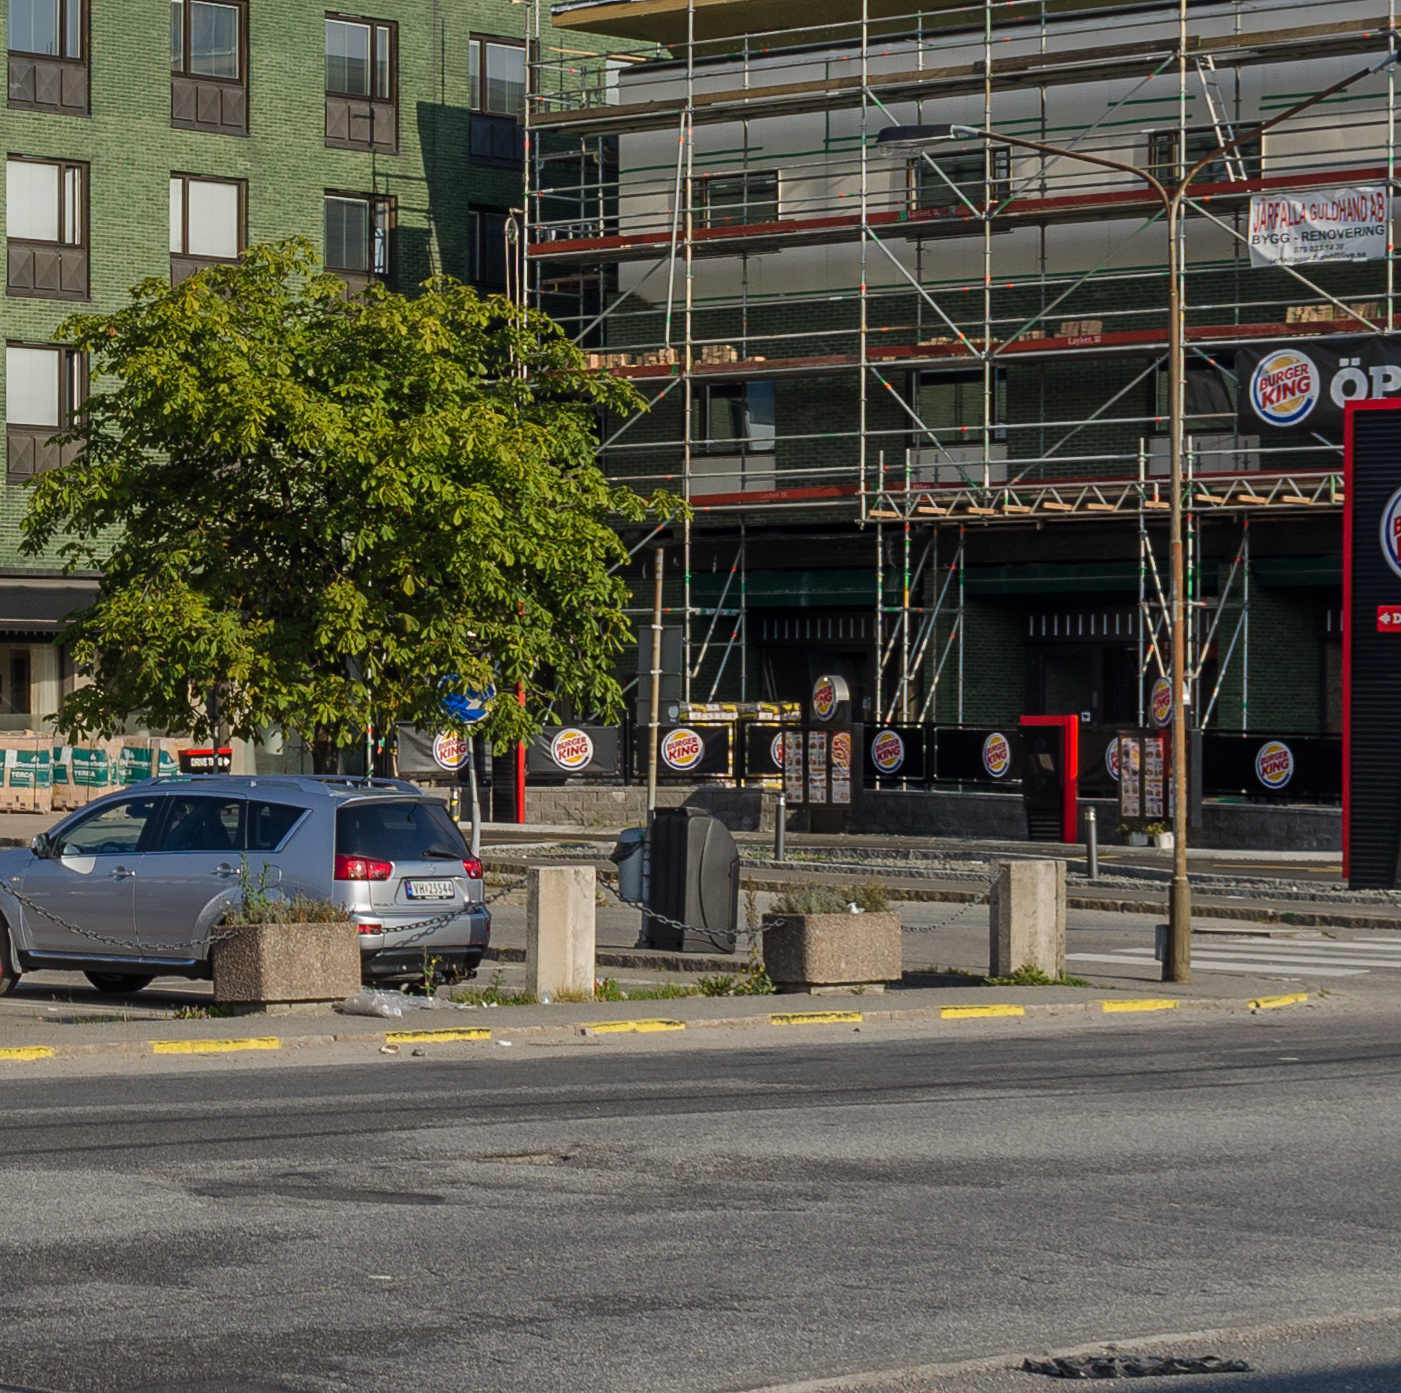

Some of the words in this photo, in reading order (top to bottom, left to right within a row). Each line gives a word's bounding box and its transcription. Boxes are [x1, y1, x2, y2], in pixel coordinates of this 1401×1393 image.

[1253, 197, 1307, 232] JÄRFÄLLA
[1310, 194, 1368, 222] GULDHAND
[1370, 192, 1385, 222] AB
[1252, 233, 1291, 245] BYGG
[1302, 224, 1385, 242] RENOVERING
[1260, 363, 1309, 392] BURGER
[1262, 376, 1311, 411] KING
[440, 744, 467, 761] KING
[556, 736, 587, 752] BURGER
[558, 743, 588, 761] KING
[667, 737, 698, 750] BURGER
[669, 744, 699, 761] KING
[876, 739, 900, 756] BURGER
[877, 746, 900, 764] KING
[1261, 750, 1288, 766] BURGER
[1262, 759, 1289, 778] KING
